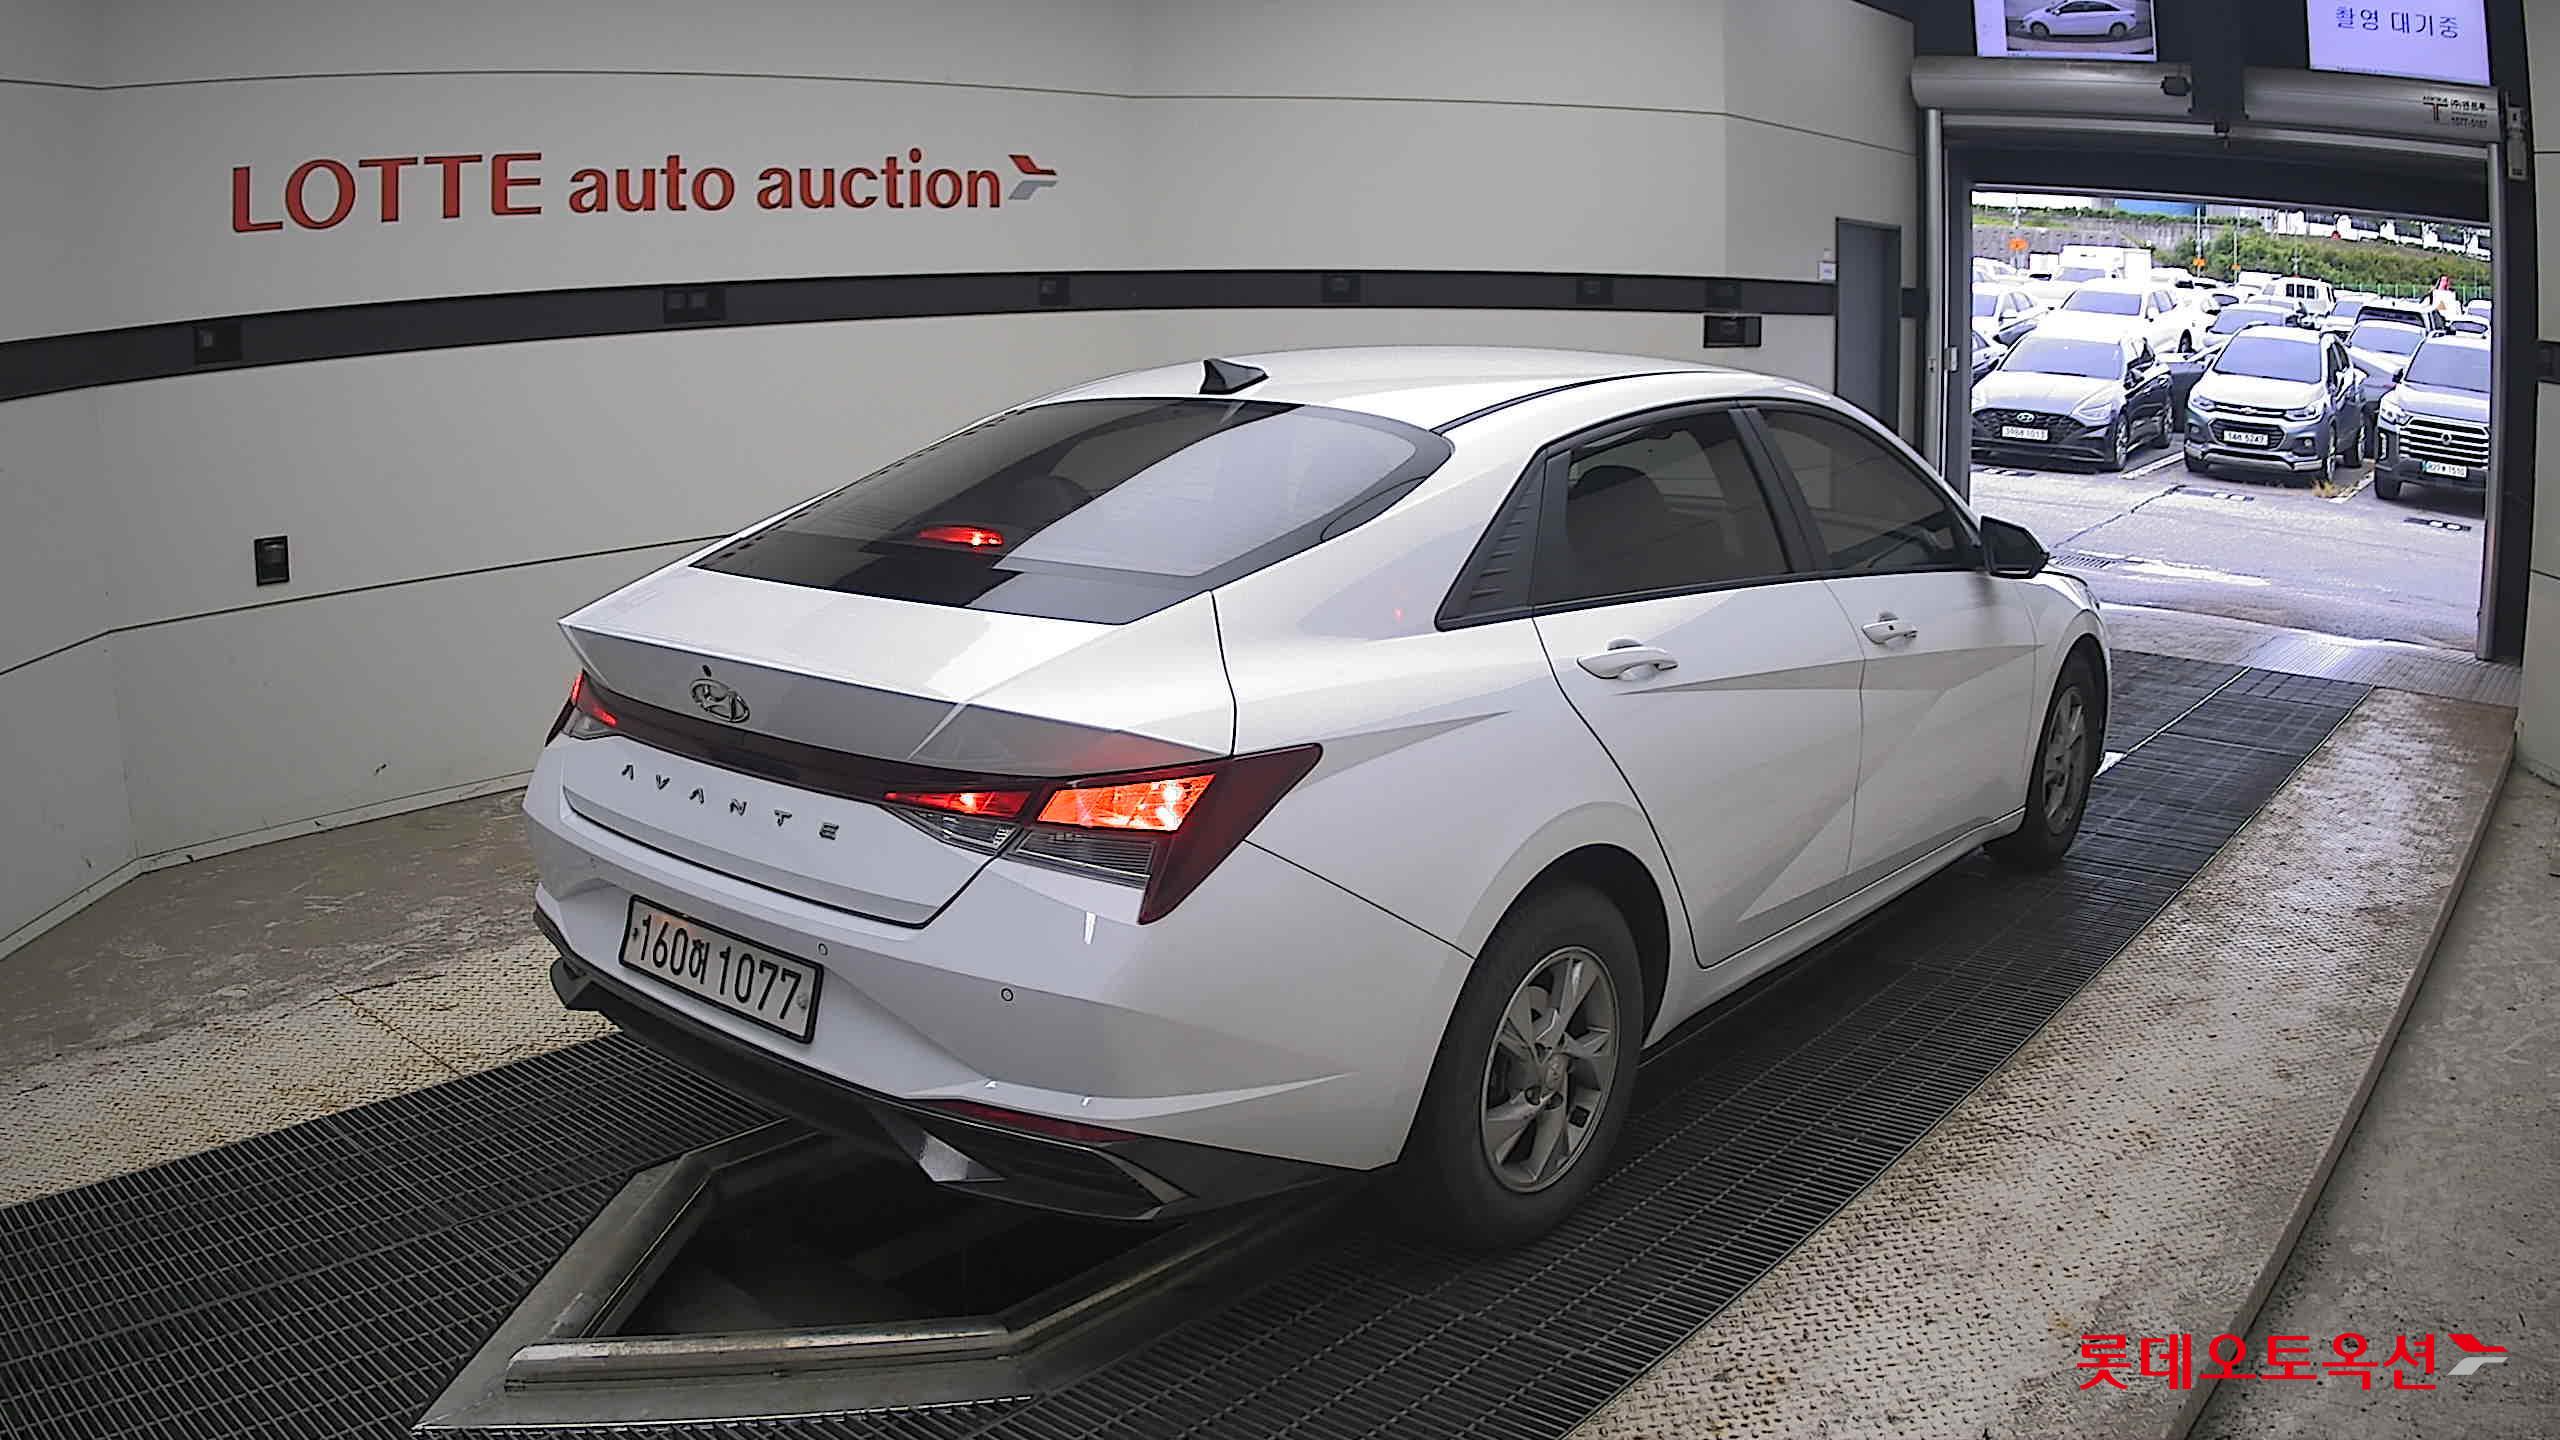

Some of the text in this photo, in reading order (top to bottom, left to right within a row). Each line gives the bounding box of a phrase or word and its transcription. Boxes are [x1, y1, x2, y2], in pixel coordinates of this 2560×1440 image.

[2336, 6, 2459, 39] 촬영 대기중
[232, 148, 1002, 233] LOTTE auto auction
[620, 763, 840, 841] AVANTE
[640, 914, 803, 1021] 160허 1077
